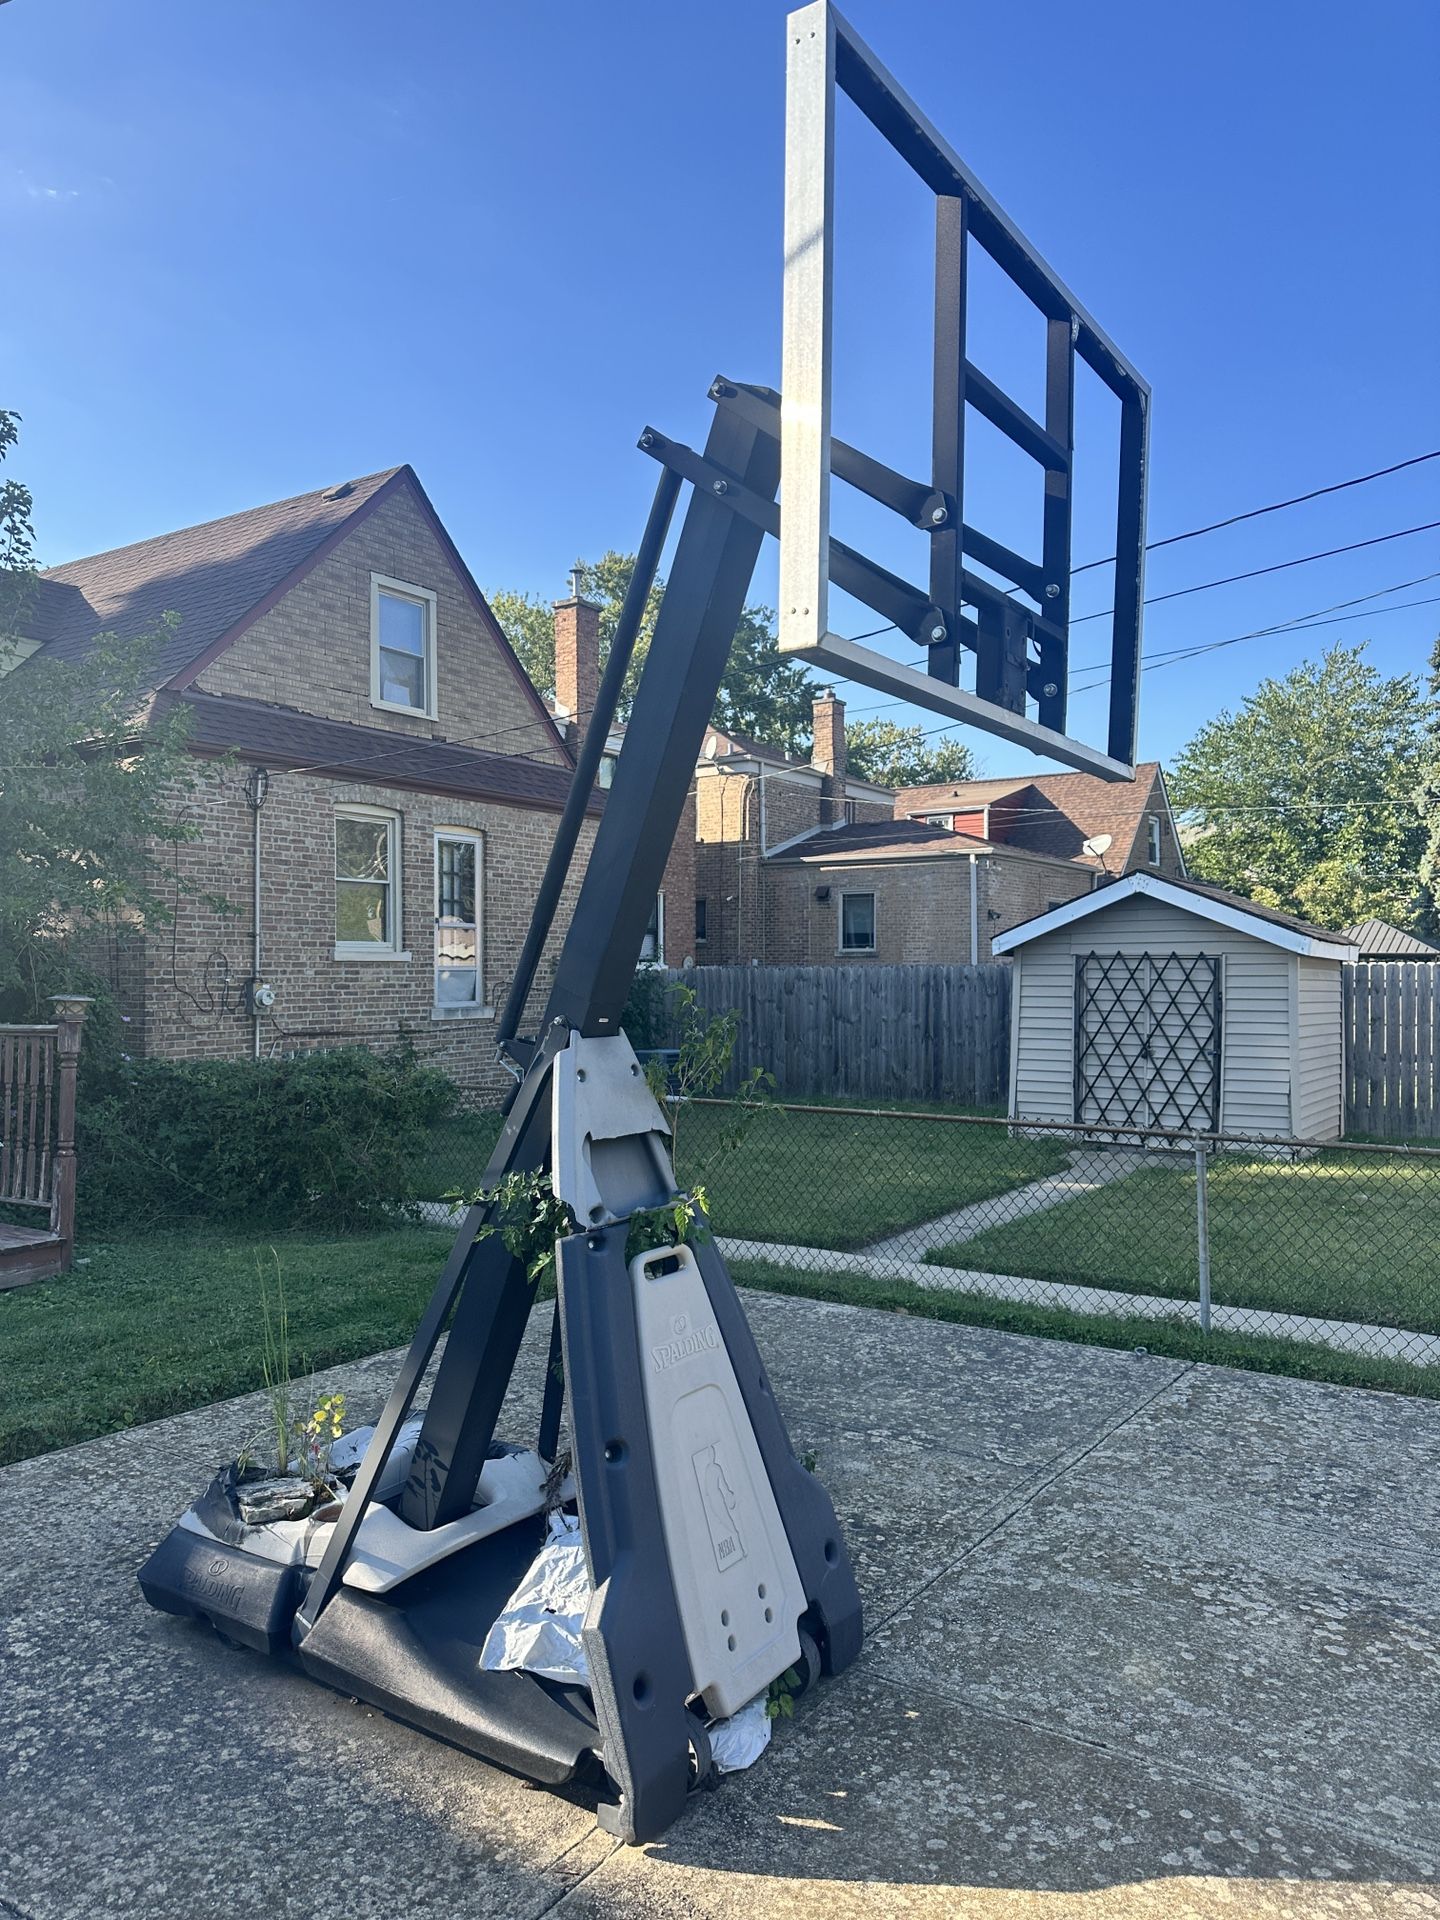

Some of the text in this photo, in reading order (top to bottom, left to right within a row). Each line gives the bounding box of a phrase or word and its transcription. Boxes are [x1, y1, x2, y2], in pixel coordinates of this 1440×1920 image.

[651, 1324, 718, 1374] SPALDING
[717, 1535, 736, 1560] NBA
[178, 1566, 246, 1612] PALDING
